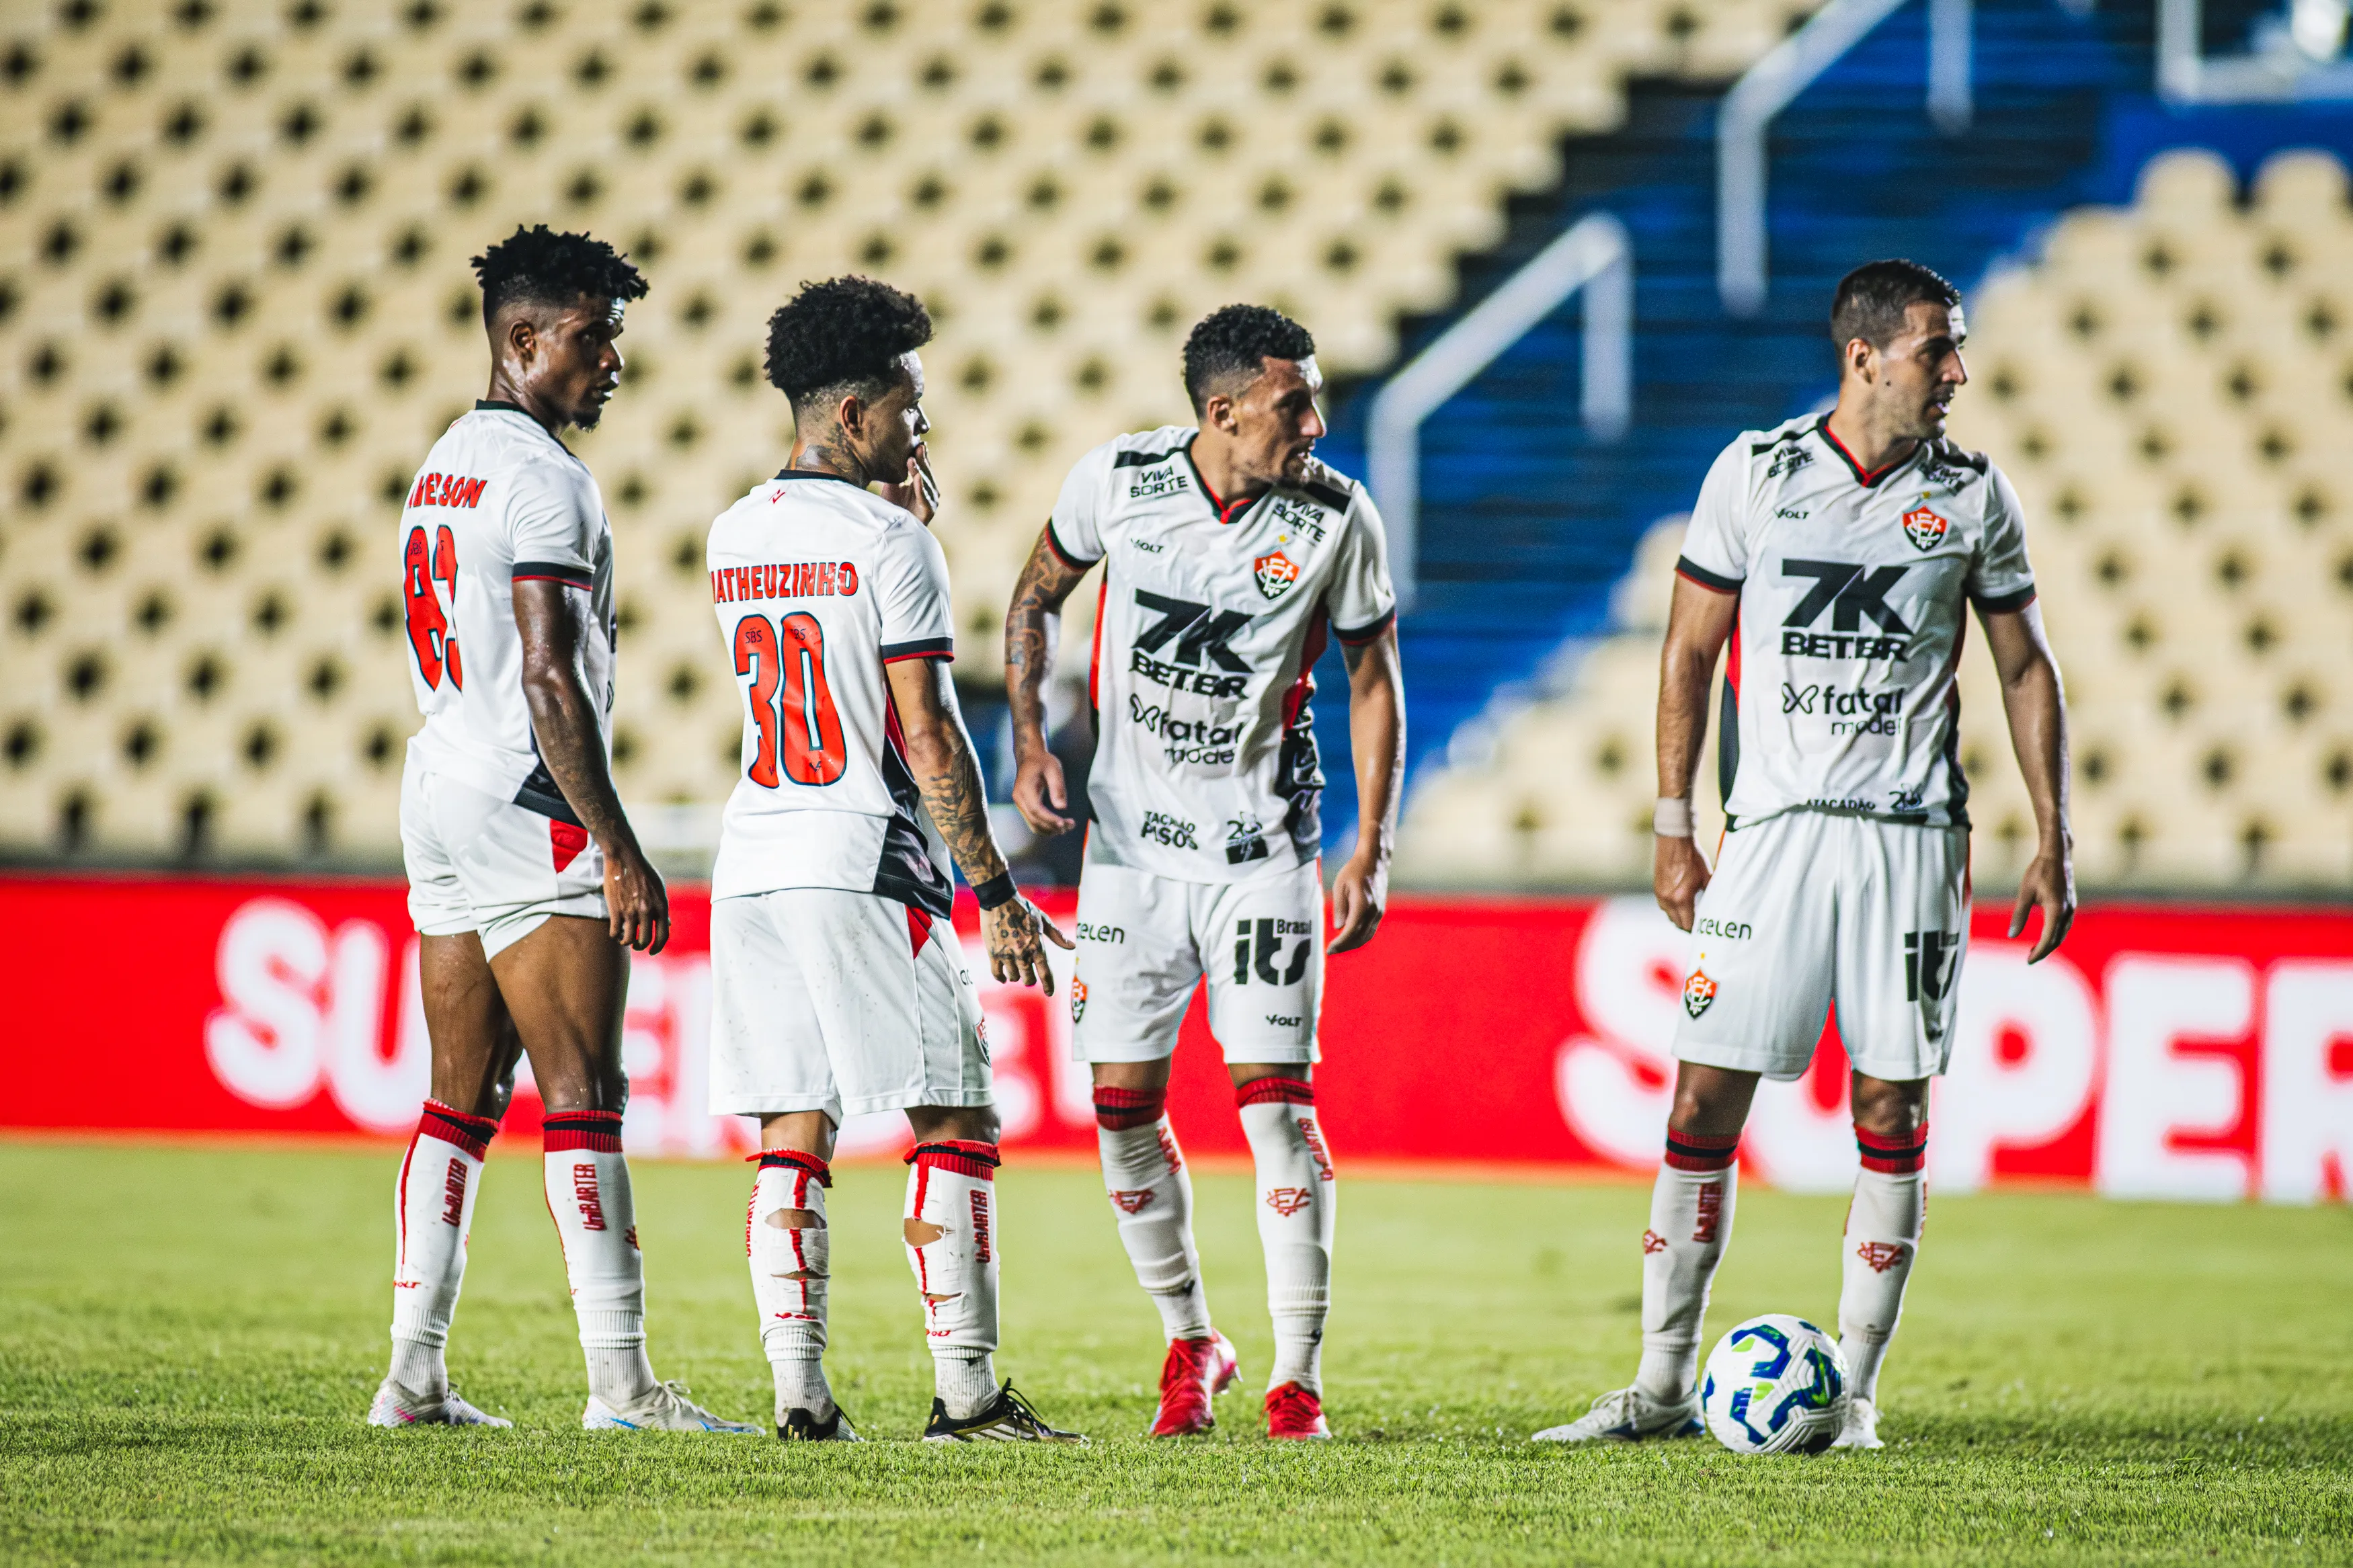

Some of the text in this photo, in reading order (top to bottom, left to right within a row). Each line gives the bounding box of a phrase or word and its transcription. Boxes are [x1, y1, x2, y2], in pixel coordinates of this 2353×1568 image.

[1130, 475, 1189, 498] SORTE
[1141, 465, 1174, 484] VIVA
[711, 561, 859, 605] ATHEUZINHO
[1781, 559, 1915, 636] 7K
[1131, 587, 1256, 674] 7K
[1780, 631, 1909, 663] BET.BR
[734, 610, 847, 788] 30
[1823, 684, 1905, 716] fatal
[1159, 711, 1244, 745] fatal
[1164, 745, 1235, 764] mode
[1077, 922, 1125, 944] elen
[1698, 918, 1752, 940] celen
[1556, 894, 2353, 1204] SPER
